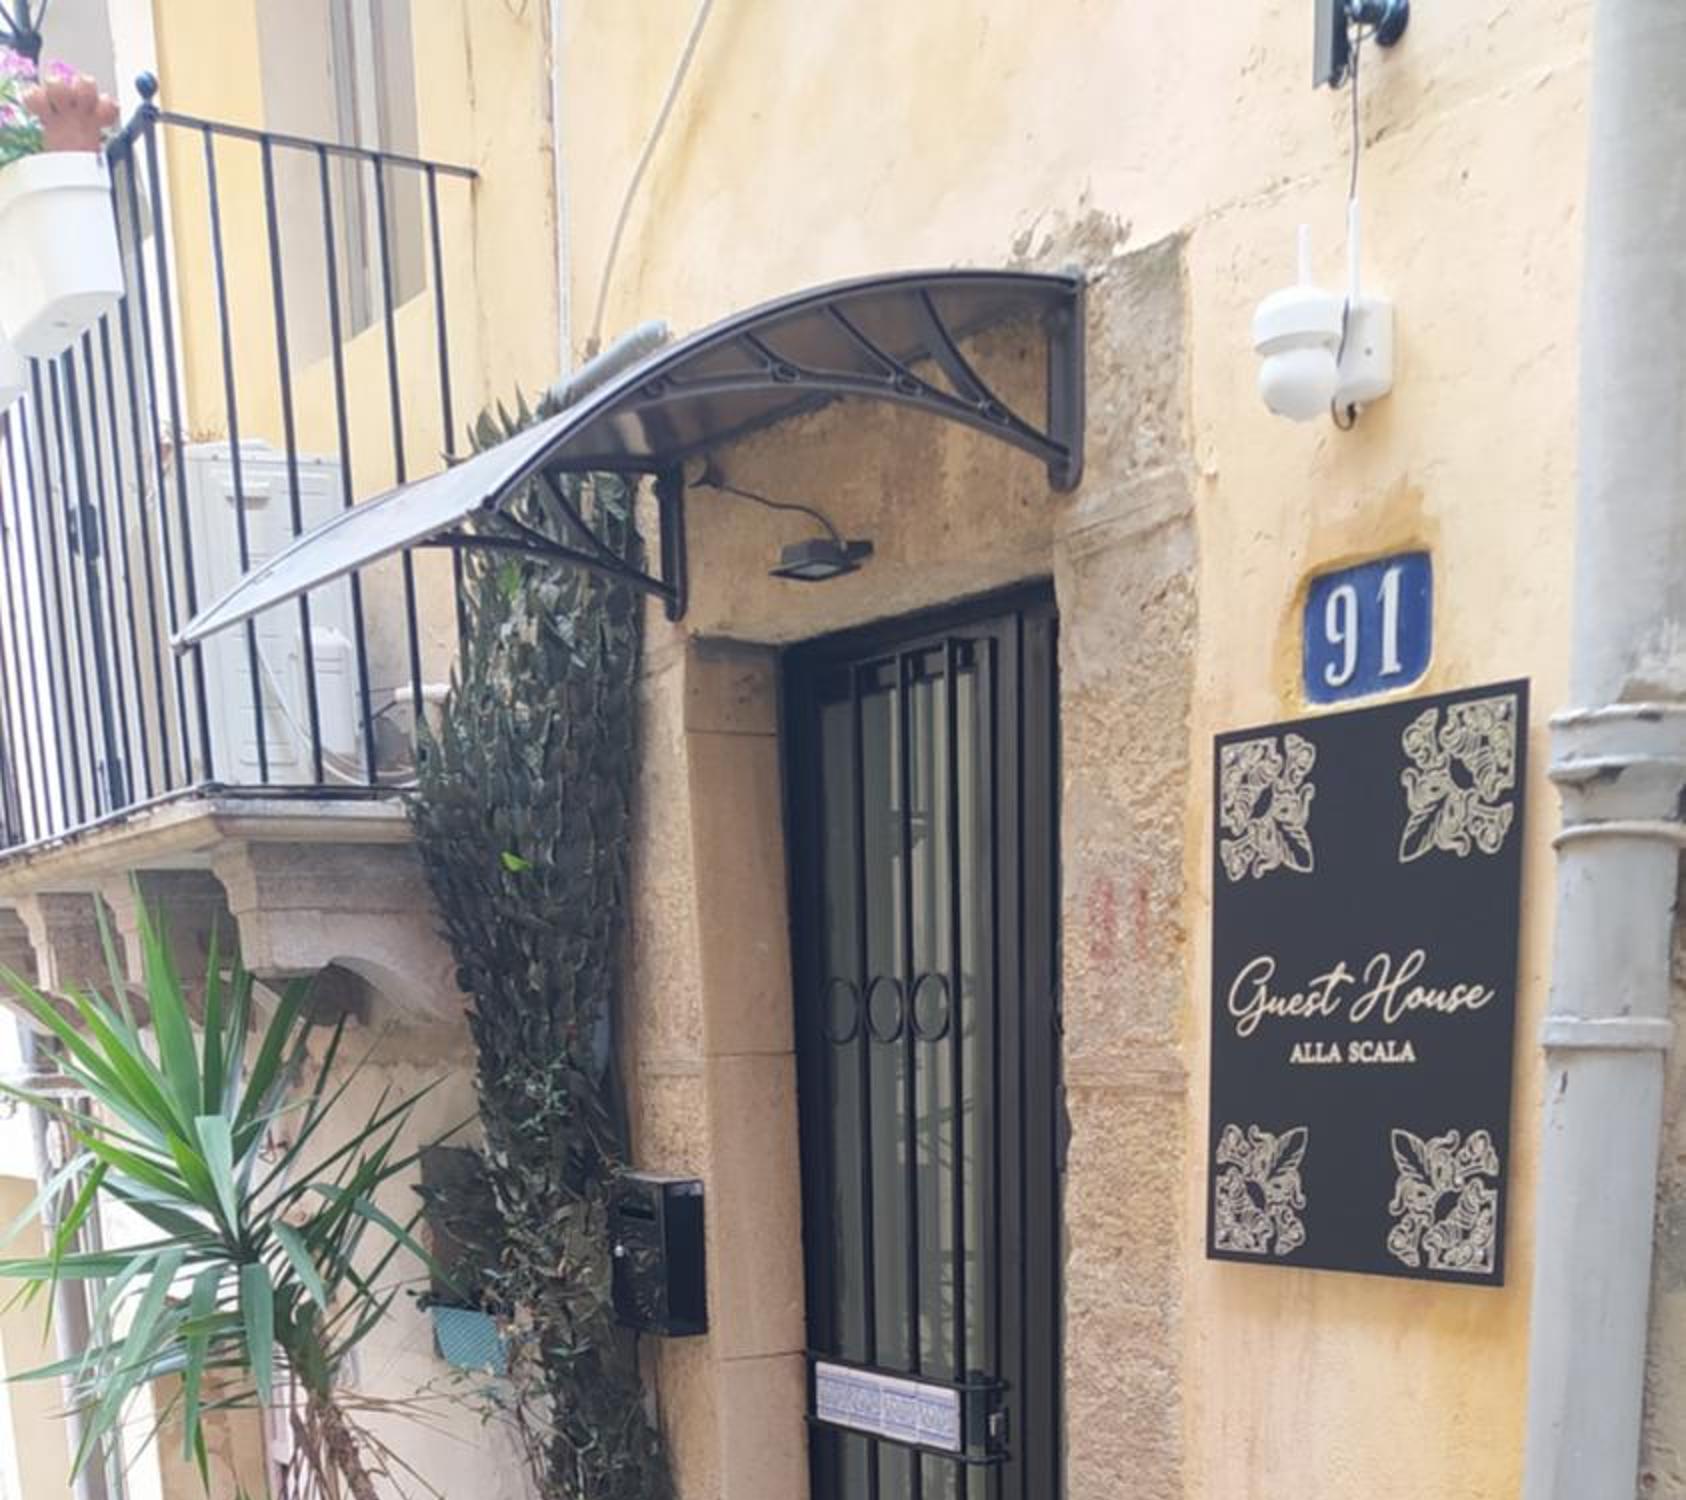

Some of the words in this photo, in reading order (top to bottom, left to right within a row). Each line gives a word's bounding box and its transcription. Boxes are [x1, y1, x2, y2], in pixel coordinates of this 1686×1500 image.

[1325, 567, 1403, 687] 91
[1228, 956, 1355, 1037] Guest
[1350, 949, 1495, 1023] House
[1289, 1042, 1342, 1063] ALLA
[1348, 1040, 1416, 1062] SCALA
